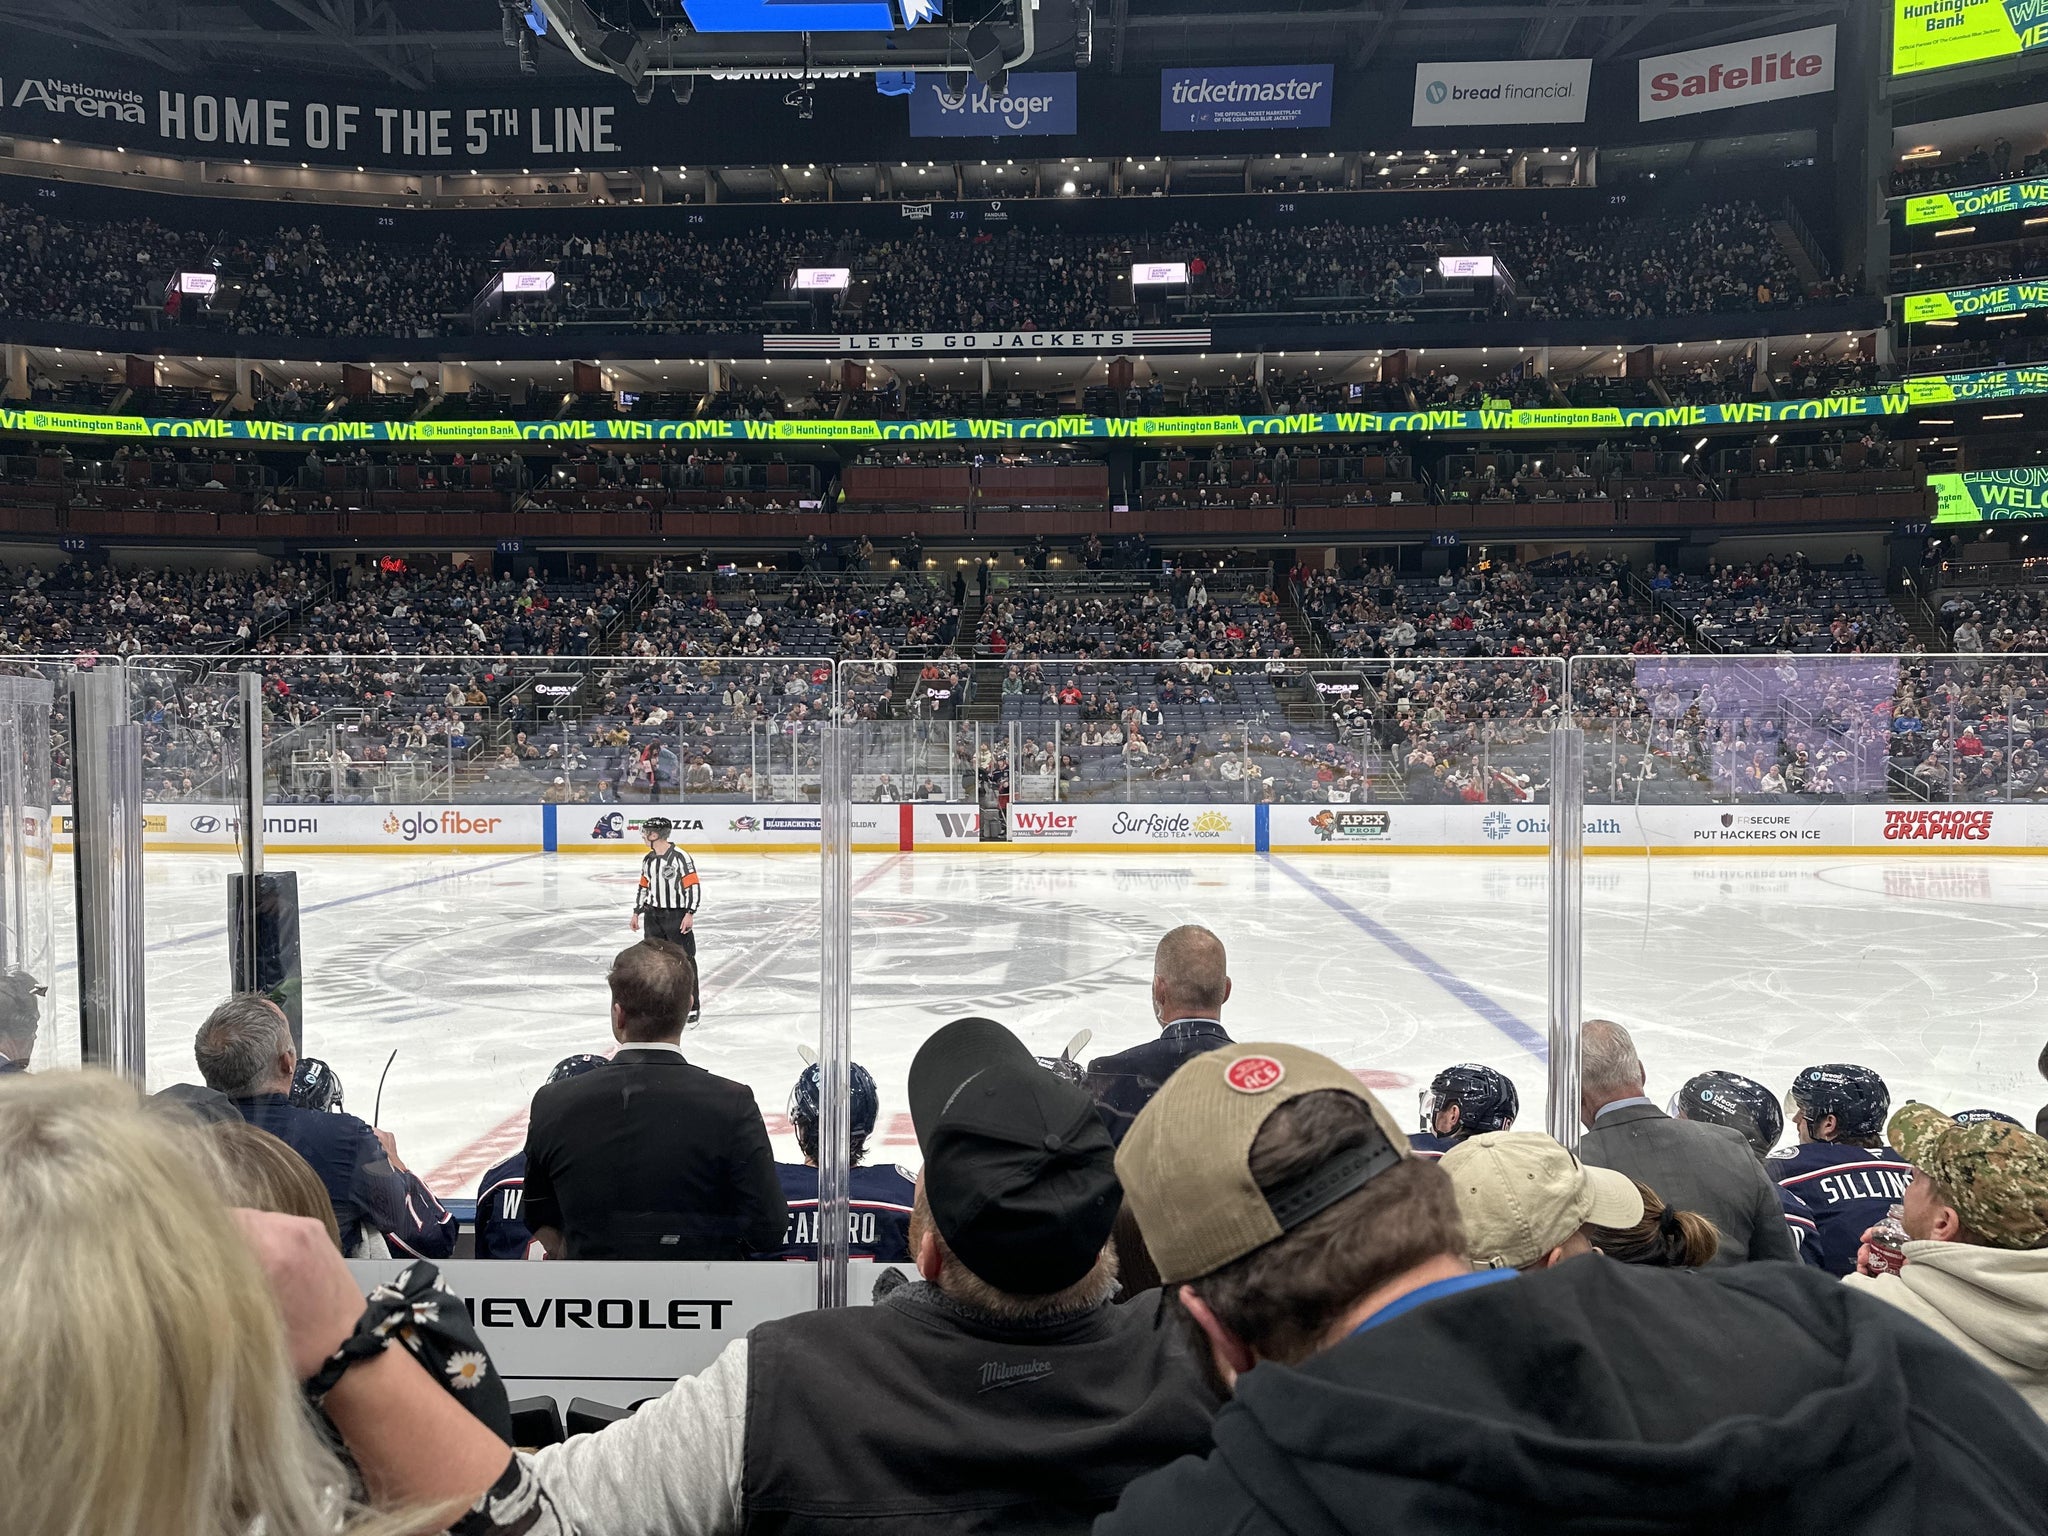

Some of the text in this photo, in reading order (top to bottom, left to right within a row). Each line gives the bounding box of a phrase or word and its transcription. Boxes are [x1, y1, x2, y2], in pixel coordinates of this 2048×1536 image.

[1904, 0, 1989, 19] Huntington
[1926, 13, 1965, 32] Bank
[1650, 50, 1822, 102] Safelite
[47, 78, 143, 104] Nationwide
[1172, 78, 1322, 104] ticketmaster
[1452, 82, 1572, 100] bread financial
[12, 79, 146, 125] Arena
[972, 84, 1053, 129] Kroger
[160, 90, 616, 156] HOME OF THE 5TH LINE
[38, 188, 56, 198] 214
[1610, 195, 1626, 204] 219
[1953, 187, 2011, 214] COME
[949, 211, 964, 219] 217
[1279, 204, 1294, 212] 218
[378, 217, 394, 226] 215
[688, 215, 703, 224] 216
[1952, 288, 2010, 313] COME
[849, 333, 1124, 349] LET'S GO JACKETS
[1951, 372, 2008, 398] COME
[51, 417, 113, 432] Huntington
[116, 420, 143, 431] Bank
[152, 419, 233, 438] COME
[436, 424, 488, 437] Huntington
[490, 426, 514, 436] Bank
[522, 421, 597, 439] COME
[796, 424, 848, 437] Huntington
[851, 425, 874, 435] Bank
[883, 420, 957, 439] COME
[1158, 422, 1212, 434] Huntington
[1214, 420, 1238, 430] Bank
[1247, 414, 1324, 434] COME
[1534, 413, 1589, 425] Huntington
[1591, 411, 1617, 422] Bank
[1626, 406, 1706, 427] COME
[1904, 524, 1927, 534] 117
[64, 540, 85, 549] 112
[501, 542, 519, 551] 113
[1436, 535, 1456, 545] 116
[63, 819, 73, 829] CA
[226, 818, 317, 833] HNDAI
[673, 819, 704, 830] ZZA
[1015, 811, 1077, 835] Wyler
[1112, 811, 1190, 834] Surfside
[1340, 814, 1385, 826] APEX
[1737, 816, 1790, 825] FRSECURE
[1885, 810, 1994, 825] TRUECHOICE
[402, 811, 501, 841] glo fiber
[1516, 818, 1621, 834] Ohialth
[1883, 823, 1991, 840] GRAPHICS
[1694, 830, 1821, 839] PUT HACKERS ON ICE
[1820, 1076, 1845, 1084] financial
[1822, 1071, 1843, 1079] bread
[1712, 1099, 1737, 1115] financial
[1714, 1095, 1737, 1110] bread
[782, 1212, 876, 1245] FARO
[978, 1359, 1053, 1386] Milwaukee
